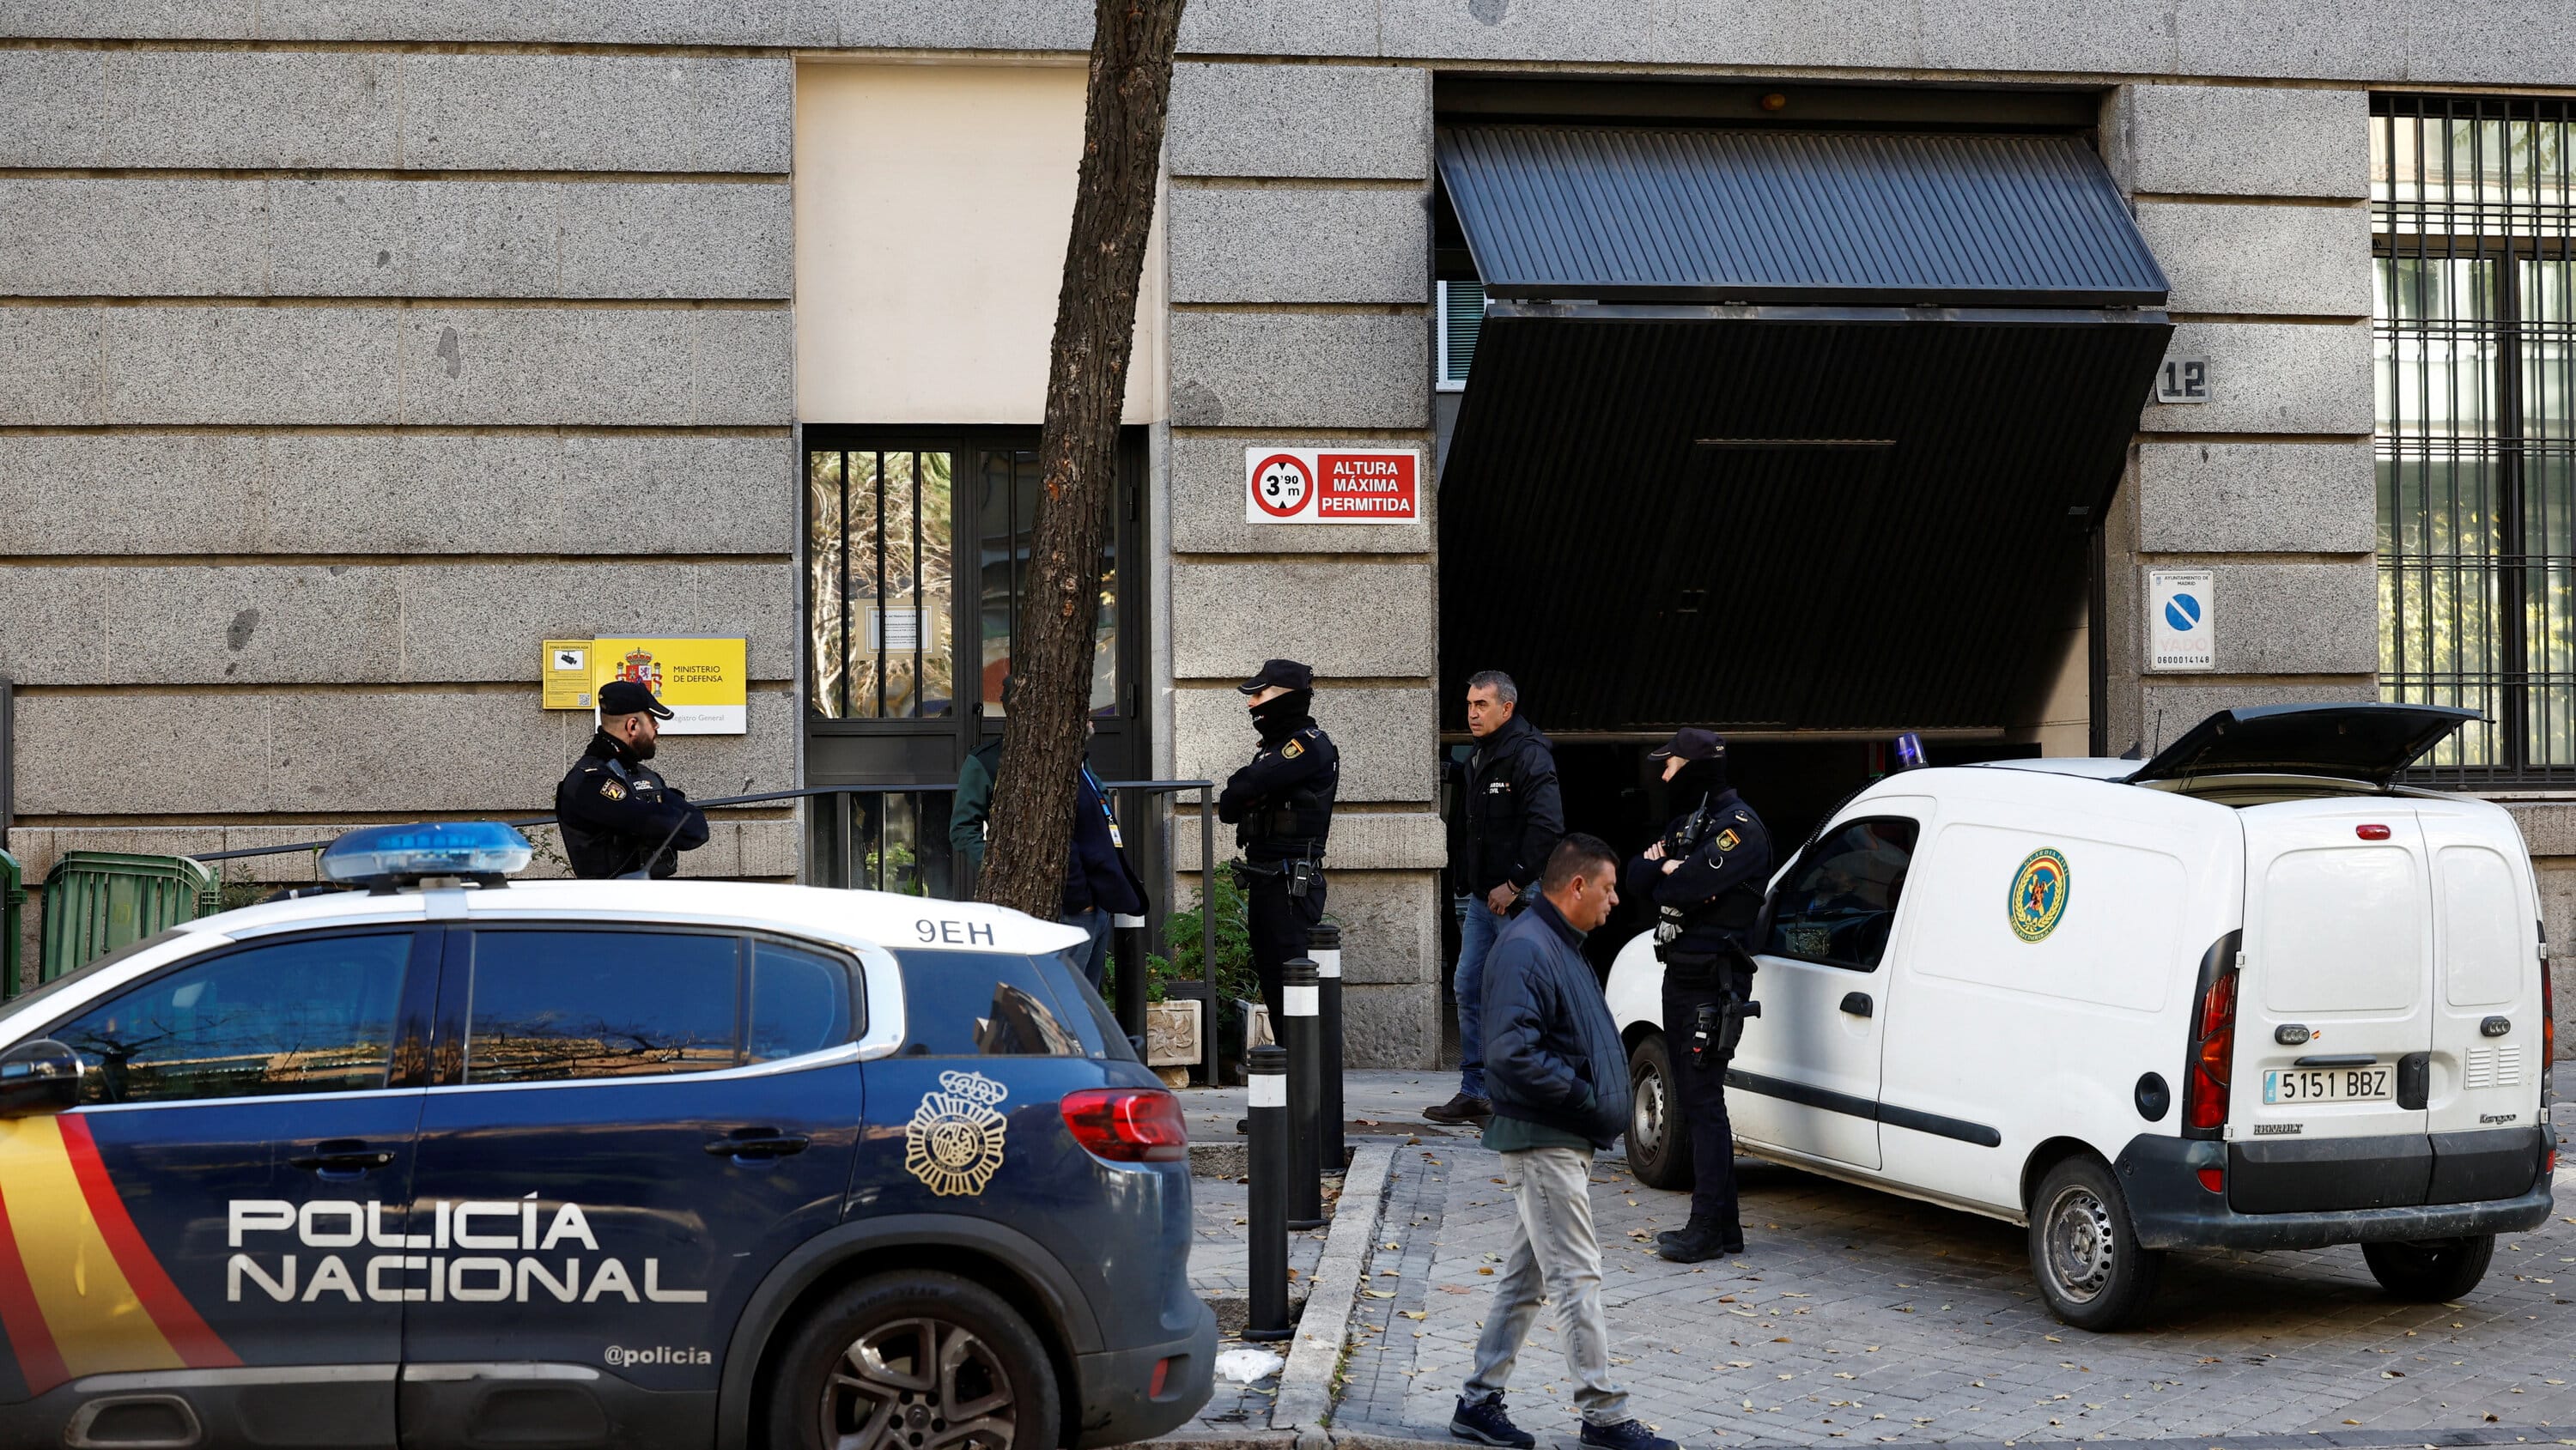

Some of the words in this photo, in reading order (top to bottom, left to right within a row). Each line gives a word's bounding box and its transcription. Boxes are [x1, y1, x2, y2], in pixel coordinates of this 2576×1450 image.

[2162, 361, 2205, 397] 12
[1334, 461, 1399, 475] ALTURA
[1333, 476, 1399, 492] MÁXIMA
[1321, 497, 1411, 512] PERMITIDA
[672, 714, 697, 723] egistro
[915, 919, 994, 946] 9EH
[2282, 1072, 2336, 1099] 5151
[2347, 1071, 2386, 1097] BBZ
[228, 1192, 599, 1250] POLICÍA
[227, 1253, 708, 1302] NACIONAL
[604, 1345, 712, 1367] @policia
